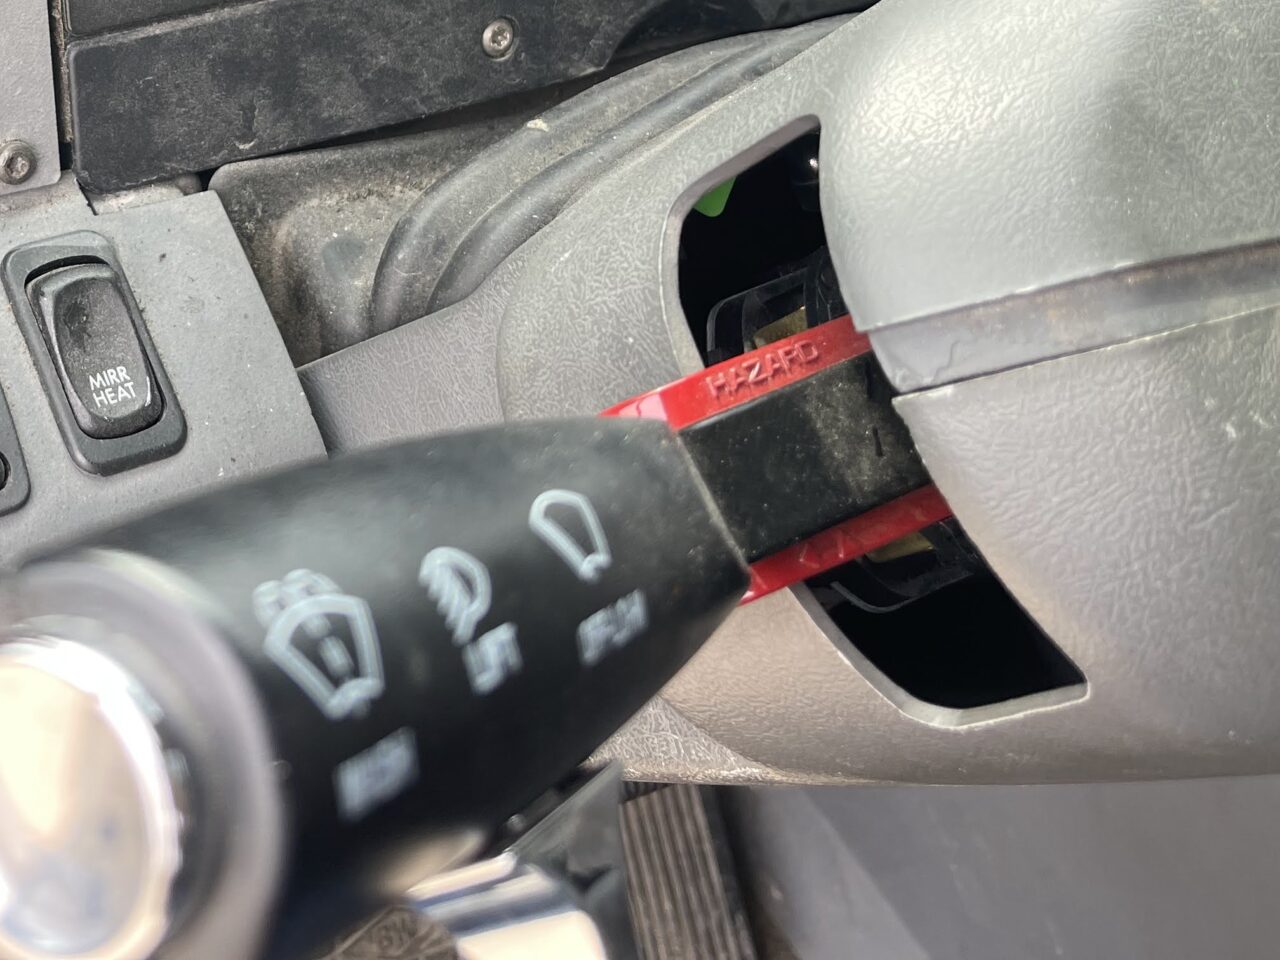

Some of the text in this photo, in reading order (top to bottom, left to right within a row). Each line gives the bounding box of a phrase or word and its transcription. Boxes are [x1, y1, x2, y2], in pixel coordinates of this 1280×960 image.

[88, 365, 132, 392] MIRR
[704, 339, 820, 400] HAZARD
[91, 382, 138, 409] HEAT
